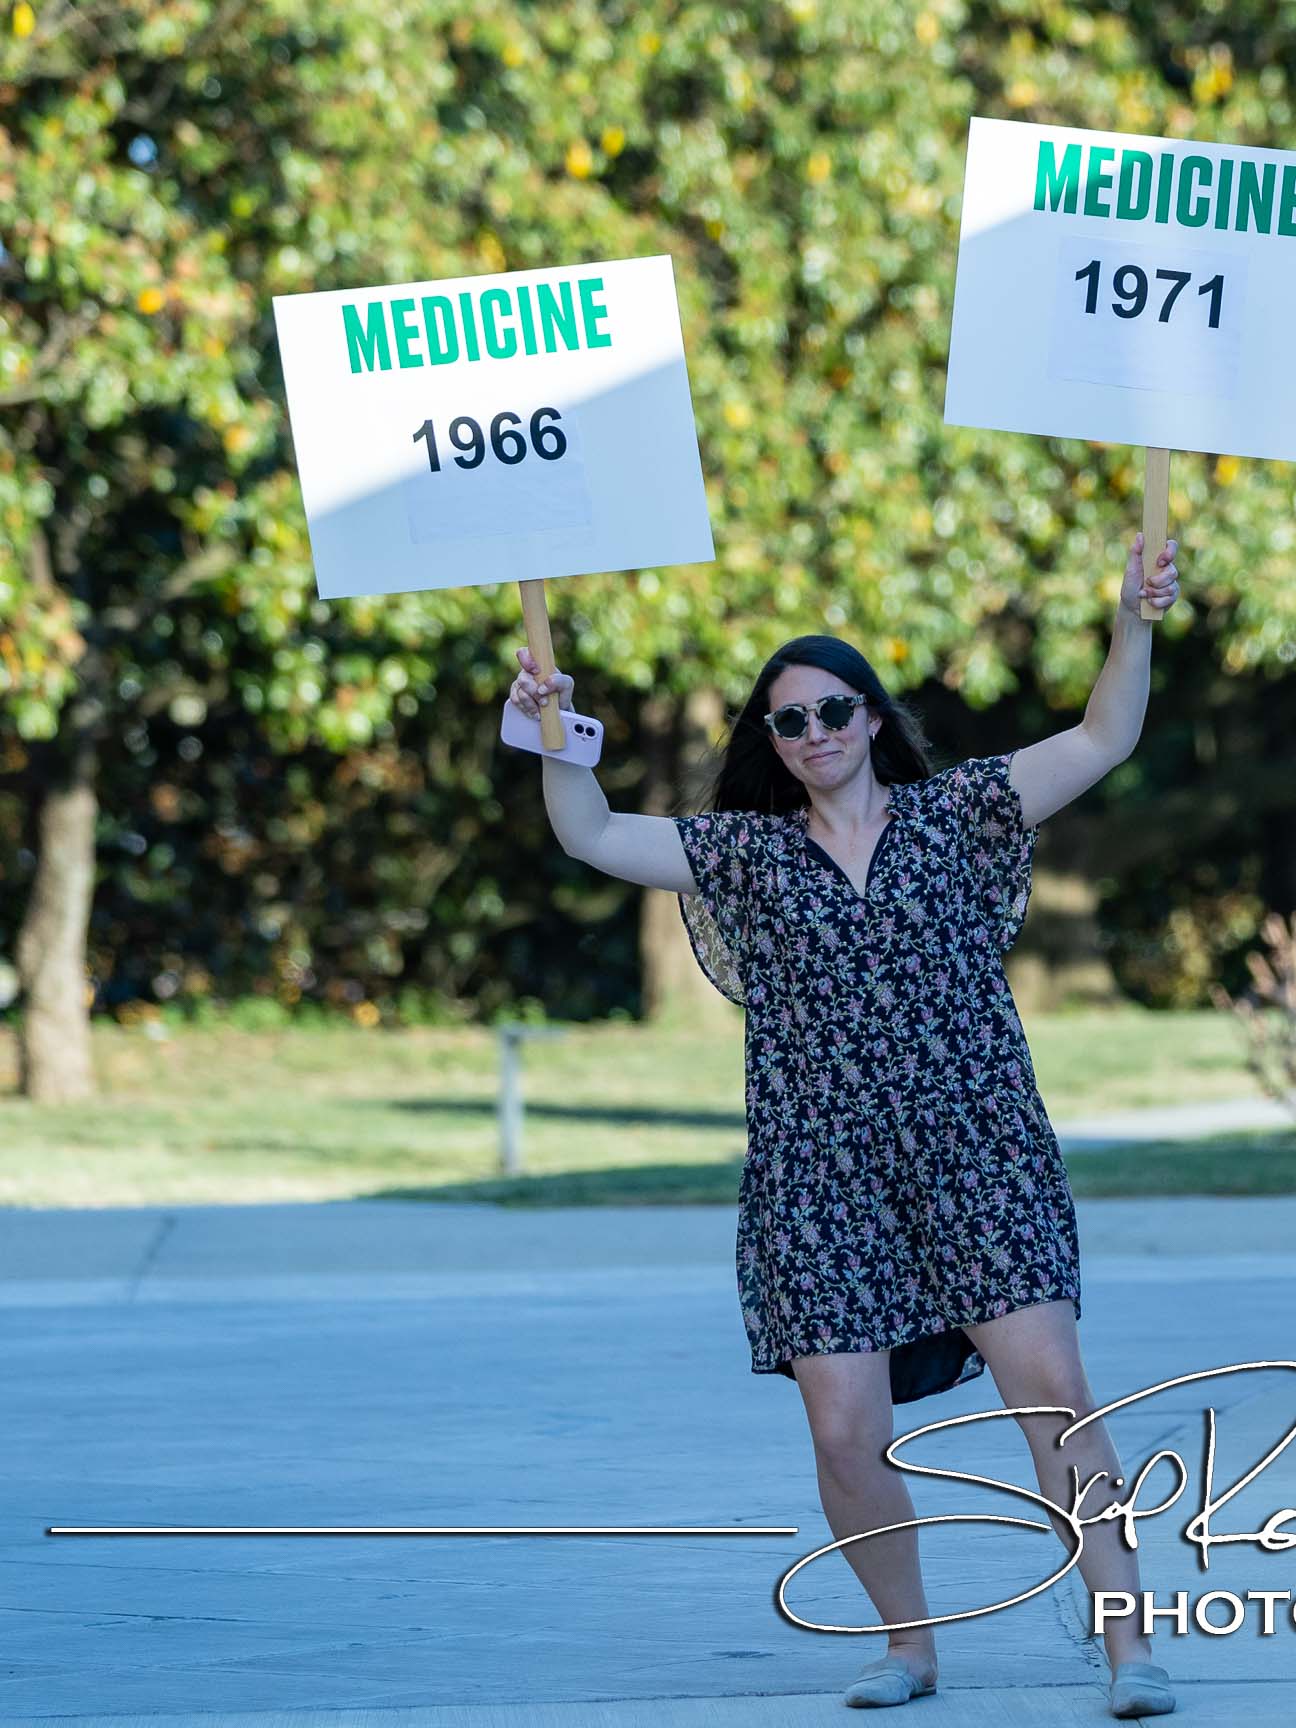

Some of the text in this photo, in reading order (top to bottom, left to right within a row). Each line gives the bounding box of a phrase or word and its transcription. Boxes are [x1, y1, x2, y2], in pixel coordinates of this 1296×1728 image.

[342, 276, 613, 375] MEDICINE
[1075, 260, 1225, 330] 1971
[412, 407, 567, 473] 1966
